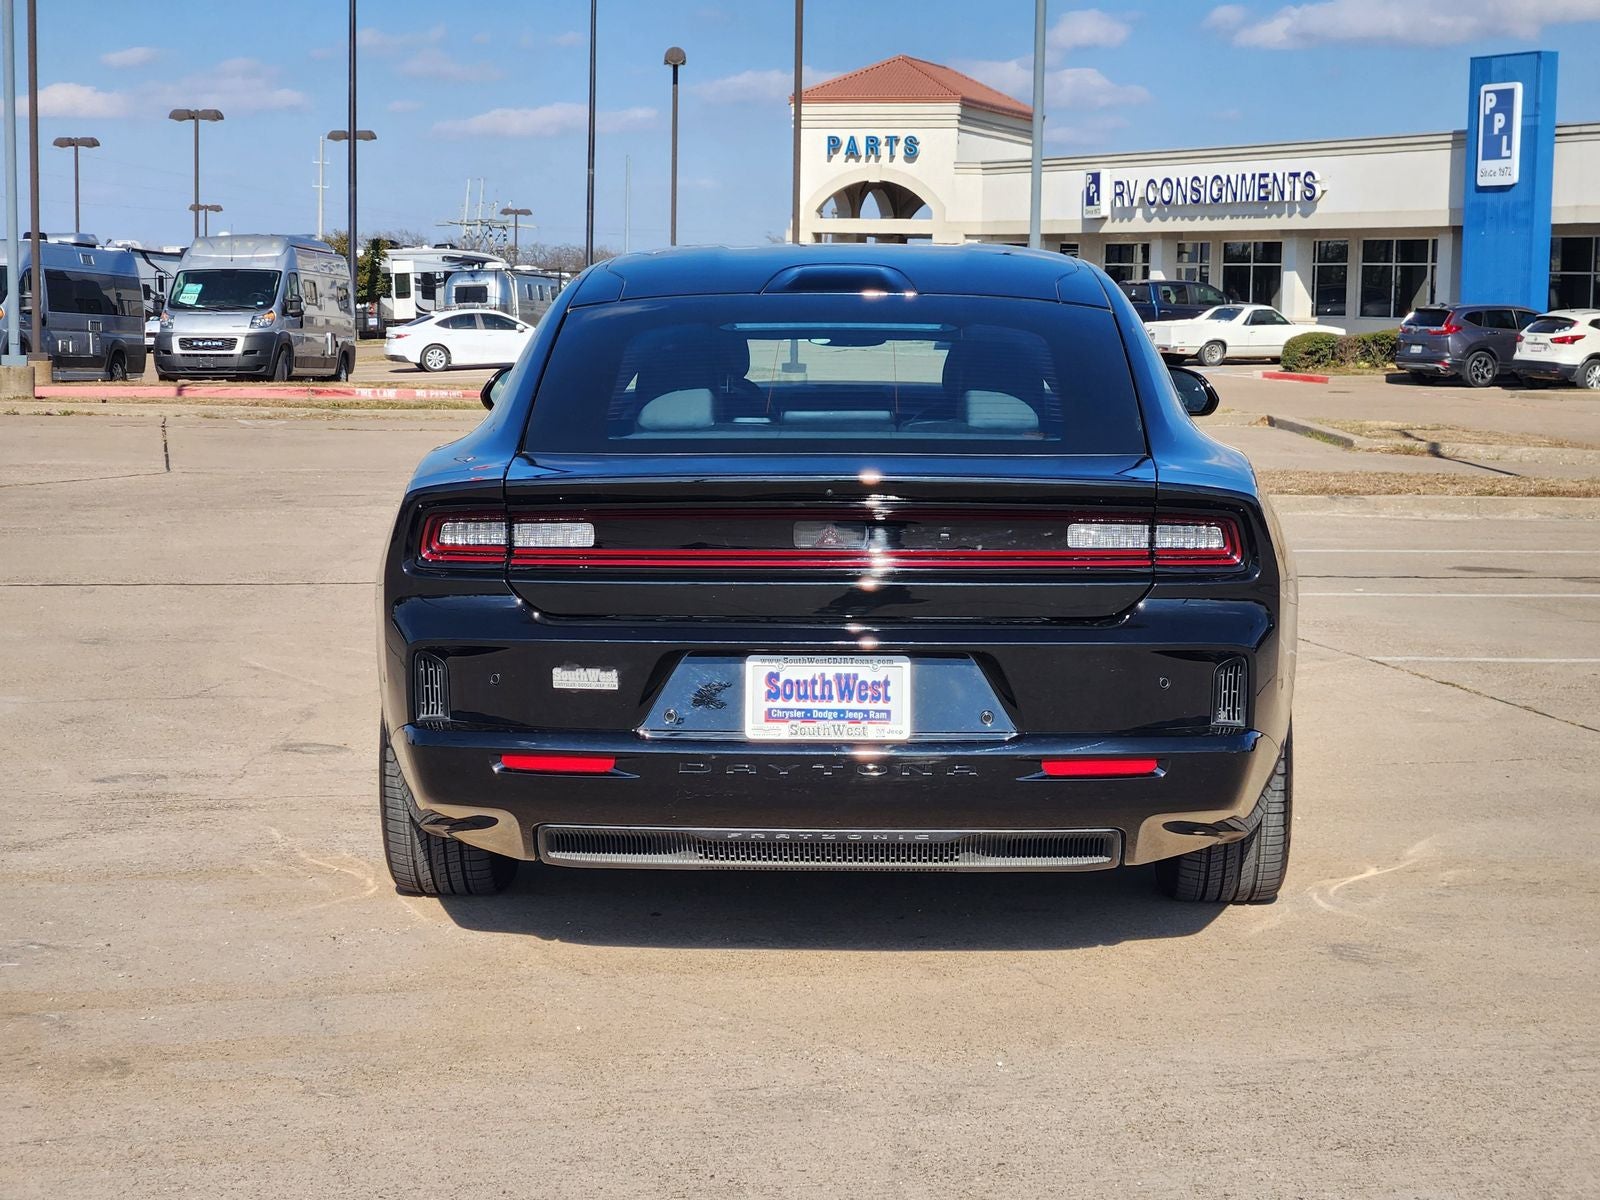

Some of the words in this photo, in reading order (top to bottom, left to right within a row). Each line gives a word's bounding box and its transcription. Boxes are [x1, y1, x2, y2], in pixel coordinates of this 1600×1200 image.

[827, 135, 919, 157] PARTS
[1480, 167, 1497, 177] Since
[1498, 166, 1512, 176] 1972
[1113, 180, 1138, 207] RV
[1146, 171, 1318, 206] CONSIGNMENTS
[553, 667, 618, 682] SouthWest
[764, 671, 891, 703] SouthWest
[771, 709, 805, 719] Chrysler
[812, 709, 838, 720] Dodge
[845, 710, 864, 720] Jeep
[869, 711, 887, 719] Ram
[789, 724, 868, 737] SouthWest
[678, 763, 979, 777] DAYTONA
[727, 831, 930, 840] FRATZONIC
